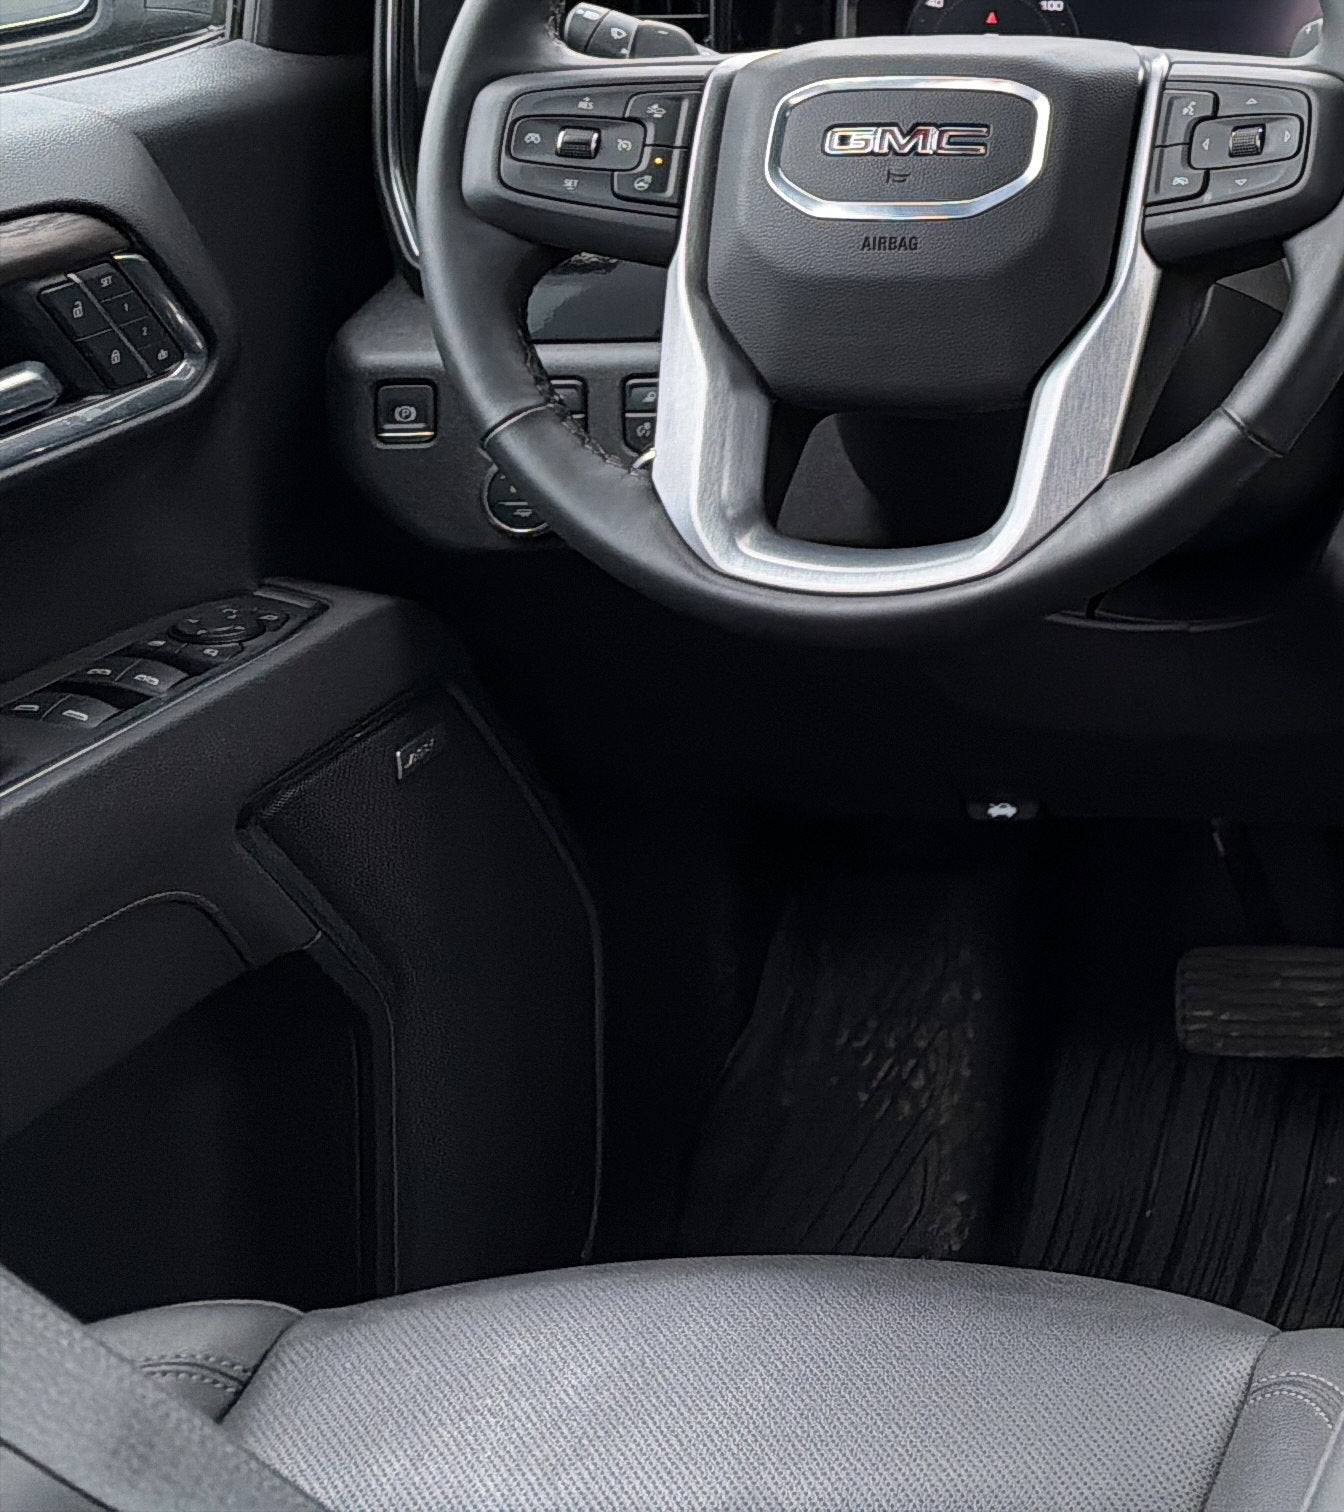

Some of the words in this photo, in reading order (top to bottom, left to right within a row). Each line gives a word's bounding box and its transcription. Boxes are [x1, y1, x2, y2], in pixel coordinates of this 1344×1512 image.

[1040, 0, 1064, 12] 100
[823, 122, 990, 156] GMC
[563, 179, 579, 188] SET
[861, 236, 919, 251] AIRBAG
